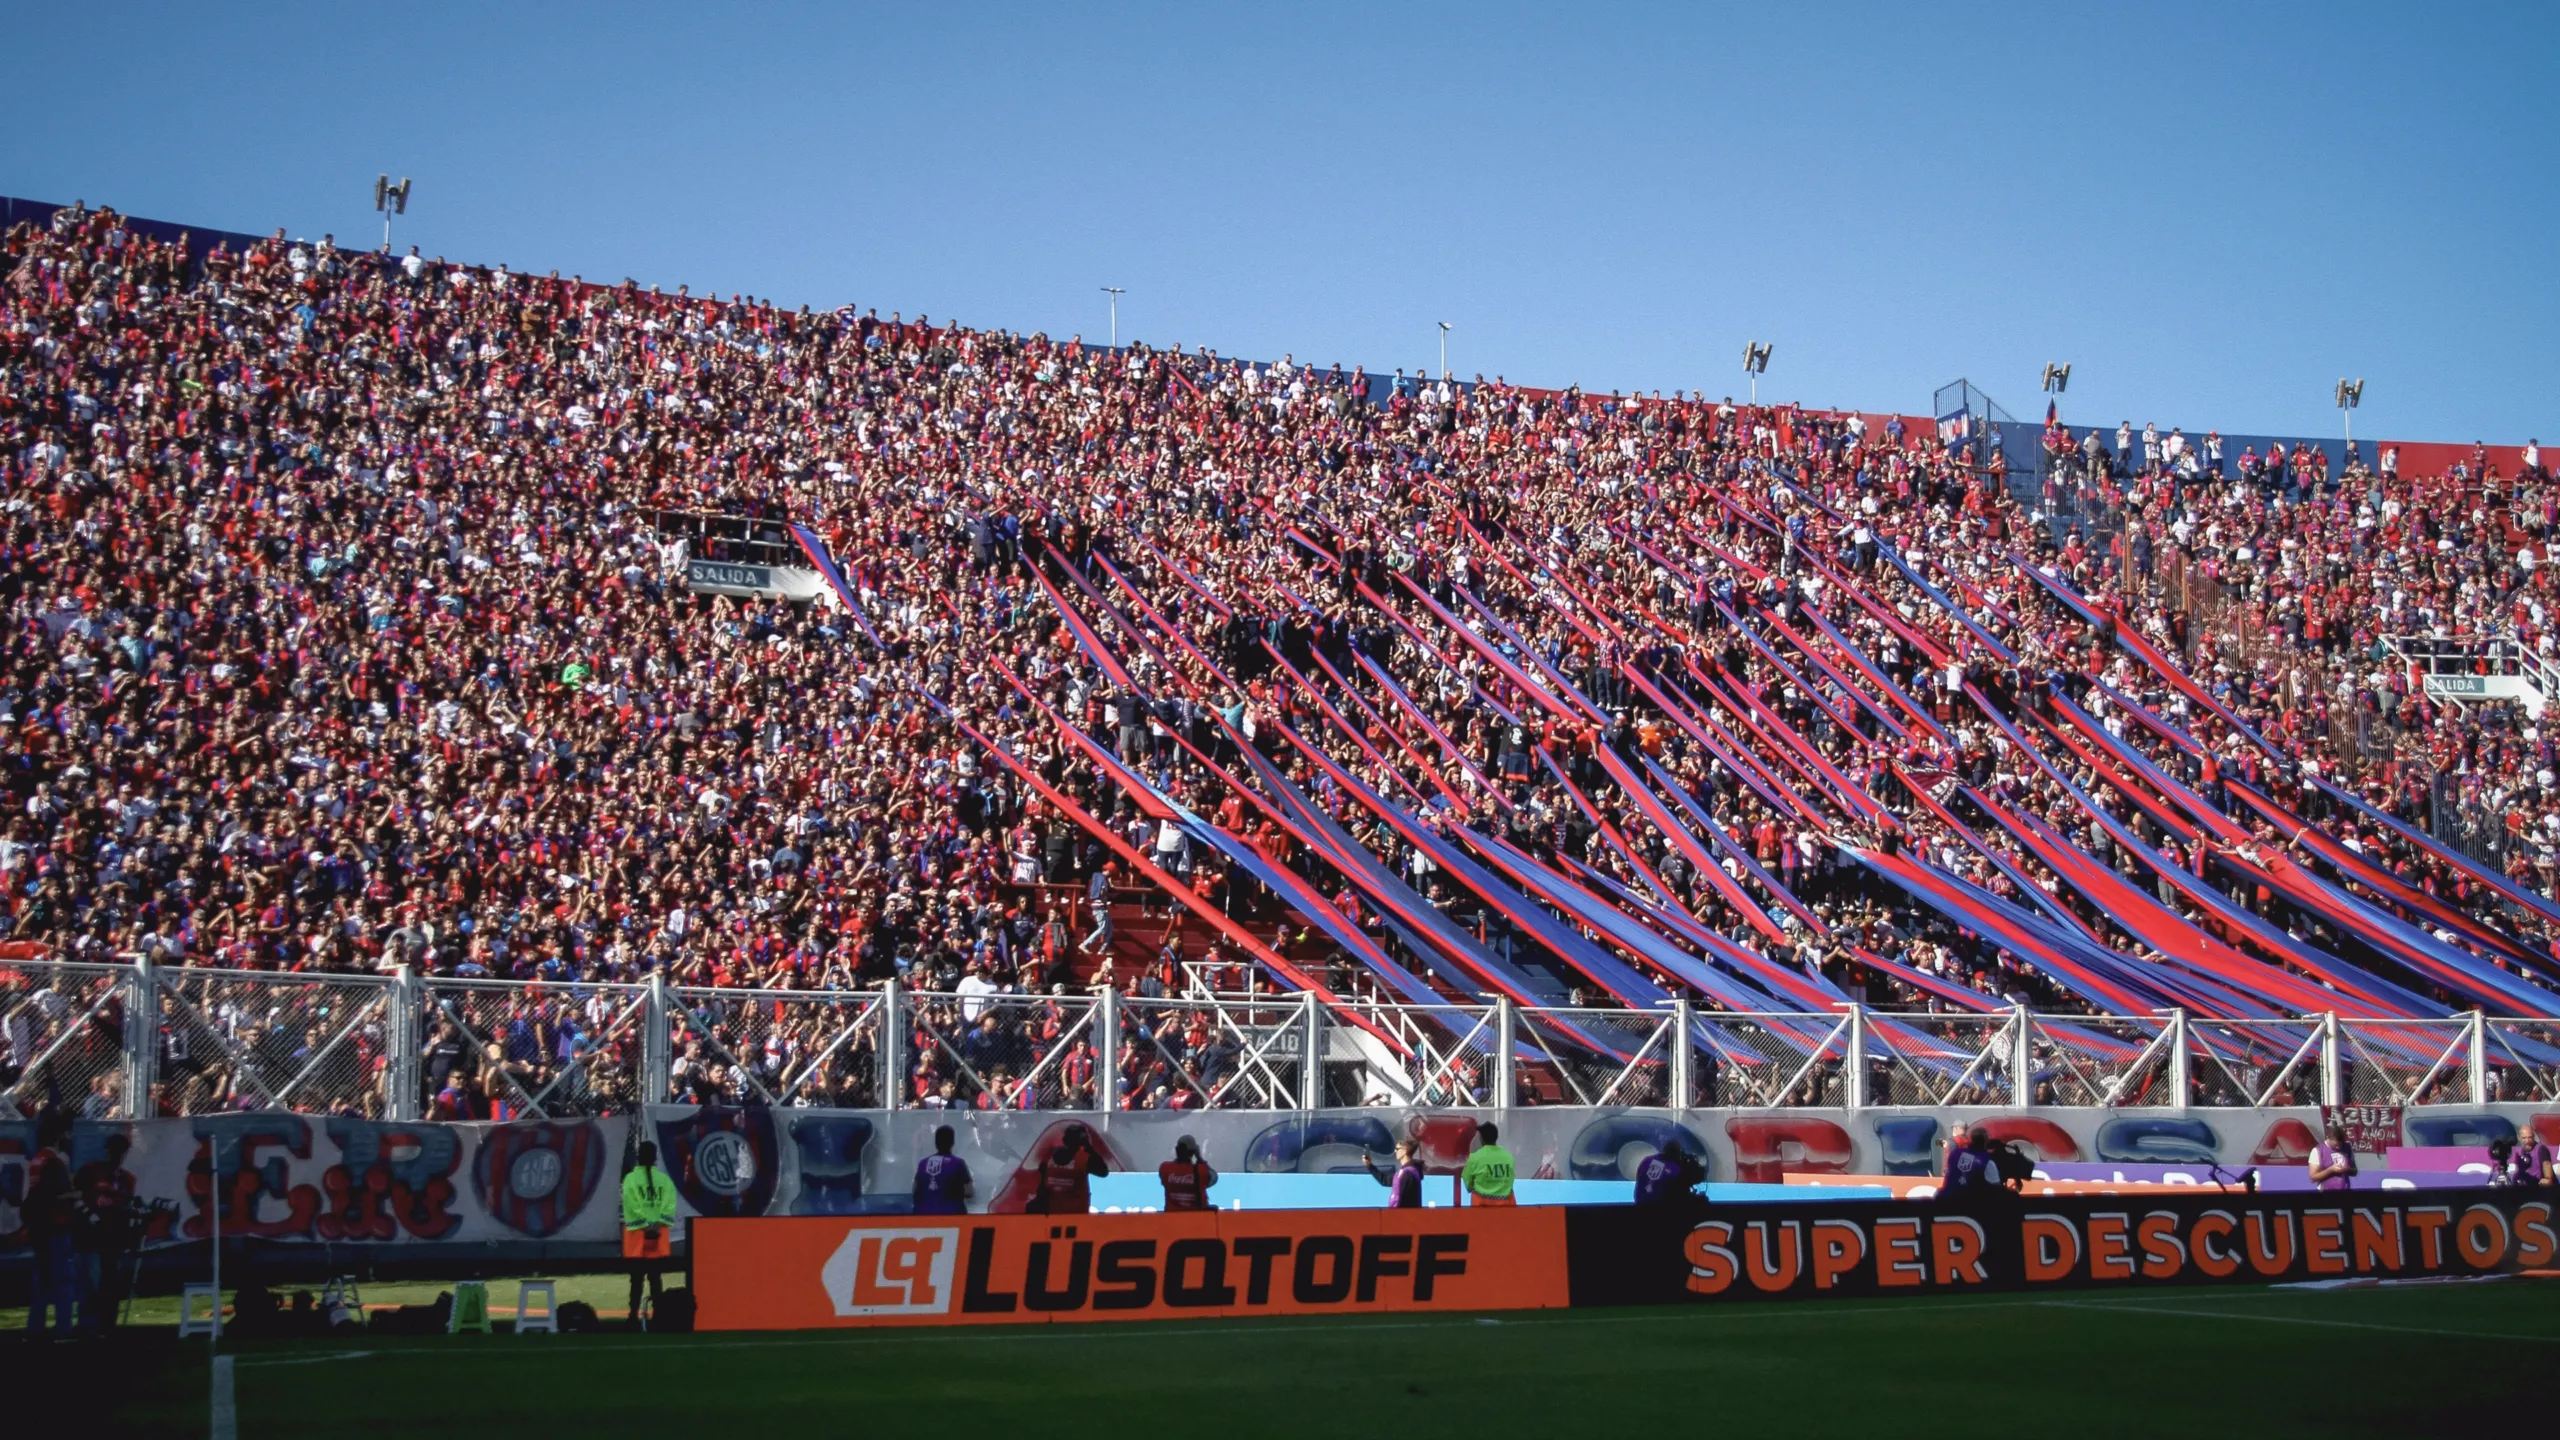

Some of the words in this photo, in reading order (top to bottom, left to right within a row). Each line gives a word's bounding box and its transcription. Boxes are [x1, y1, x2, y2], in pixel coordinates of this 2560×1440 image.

[692, 566, 758, 584] SALIDA
[2427, 679, 2475, 691] SALIDA
[1244, 1032, 1300, 1052] SALID
[2326, 1106, 2396, 1127] AZUL
[1485, 1163, 1510, 1178] MM
[1684, 1215, 1988, 1295] SUPER
[2020, 1201, 2559, 1283] DESCUENTOS
